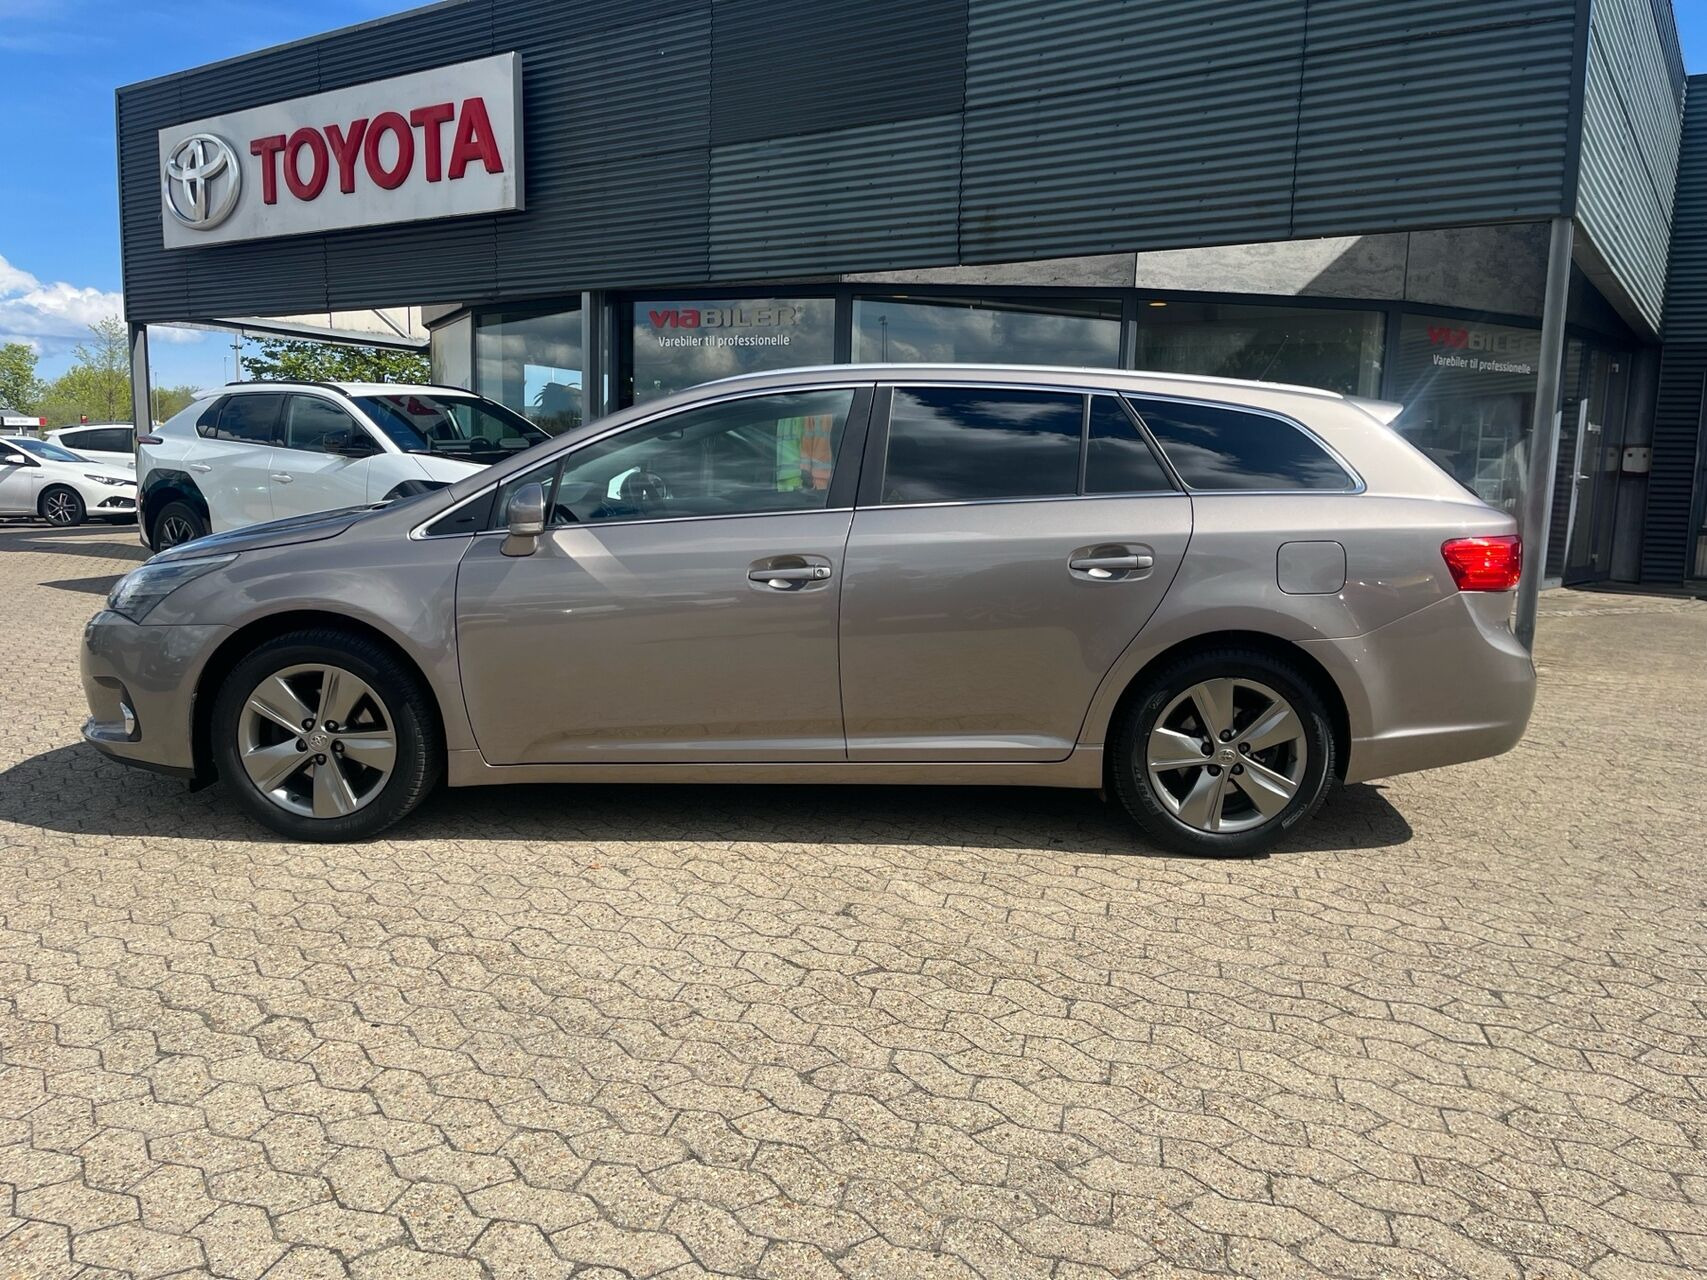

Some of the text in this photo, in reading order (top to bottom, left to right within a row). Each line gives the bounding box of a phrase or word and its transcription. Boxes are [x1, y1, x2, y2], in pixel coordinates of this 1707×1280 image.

[250, 97, 504, 205] TOYOTA
[658, 333, 791, 348] Varebiler til professionelle
[1433, 354, 1531, 374] Varebiler til professionelle
